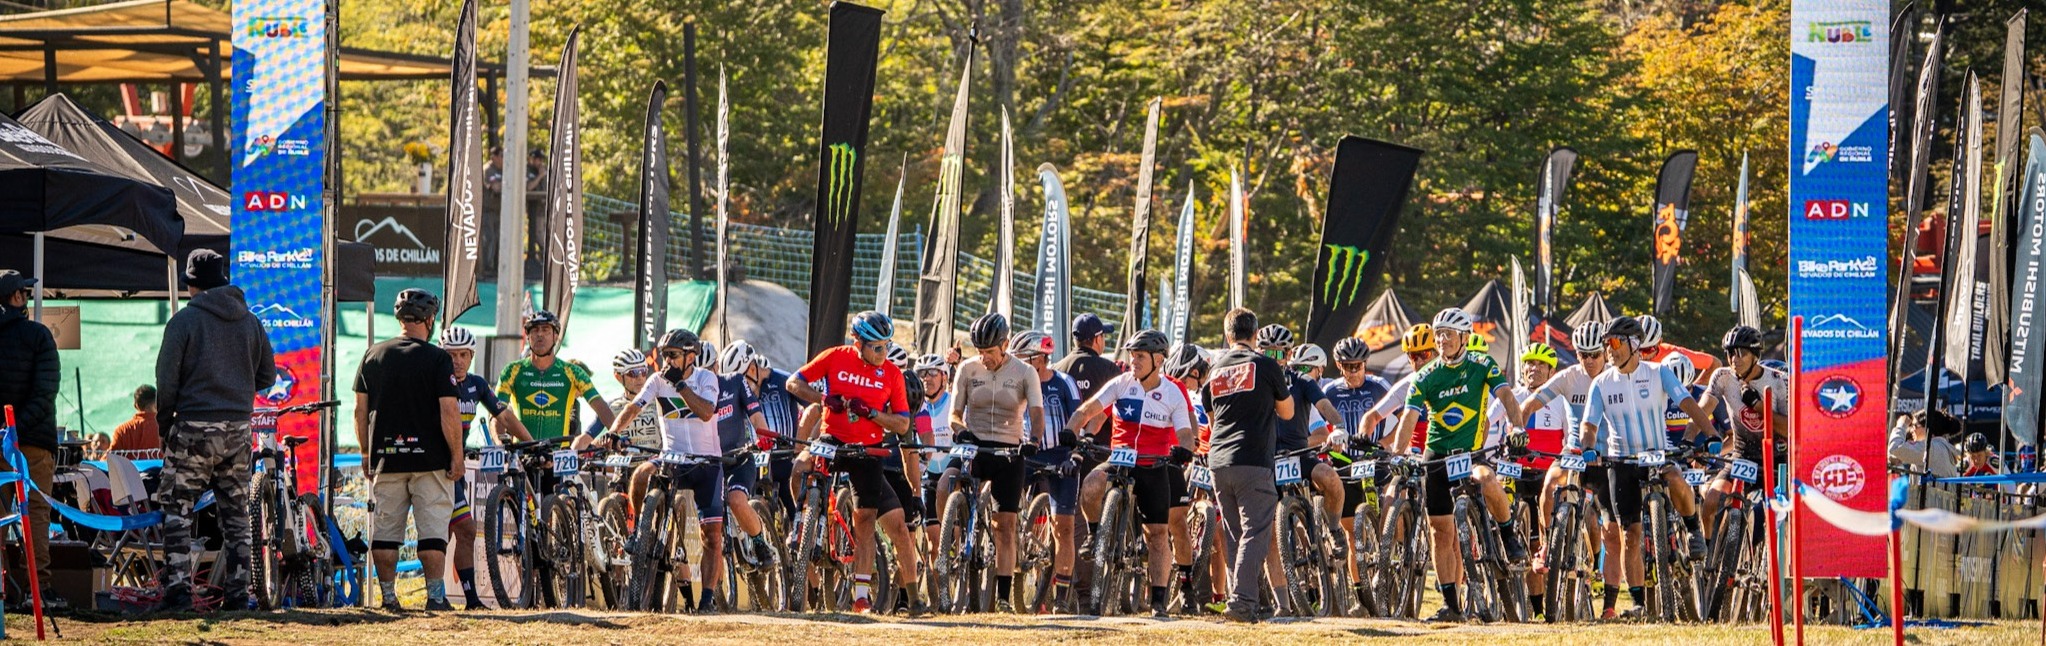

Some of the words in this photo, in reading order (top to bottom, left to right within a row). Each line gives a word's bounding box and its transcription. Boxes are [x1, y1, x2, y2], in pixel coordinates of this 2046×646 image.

[248, 194, 305, 209] ADN
[1808, 202, 1869, 217] ADN
[386, 248, 398, 261] DE
[400, 246, 439, 263] CHILLÁN
[1798, 260, 1828, 272] Bike
[284, 318, 313, 328] CHILLÁN
[1971, 280, 1987, 360] TRAILBUILDERS
[1835, 330, 1845, 338] DE
[1847, 329, 1879, 338] CHILLÁN
[838, 370, 884, 389] CHILE
[1439, 384, 1468, 399] CAIXA
[1337, 397, 1374, 411] ARG
[522, 408, 561, 416] BRASIL
[1144, 411, 1167, 422] CHILE
[250, 415, 277, 426] STAFF
[813, 444, 834, 455] 712
[483, 451, 503, 466] 710
[555, 456, 577, 470] 720
[1113, 451, 1135, 463] 714
[1563, 457, 1585, 468] 726
[1277, 463, 1299, 478] 716
[1353, 463, 1373, 475] 734
[1448, 458, 1469, 475] 717
[1499, 464, 1520, 475] 735
[1733, 463, 1756, 478] 729
